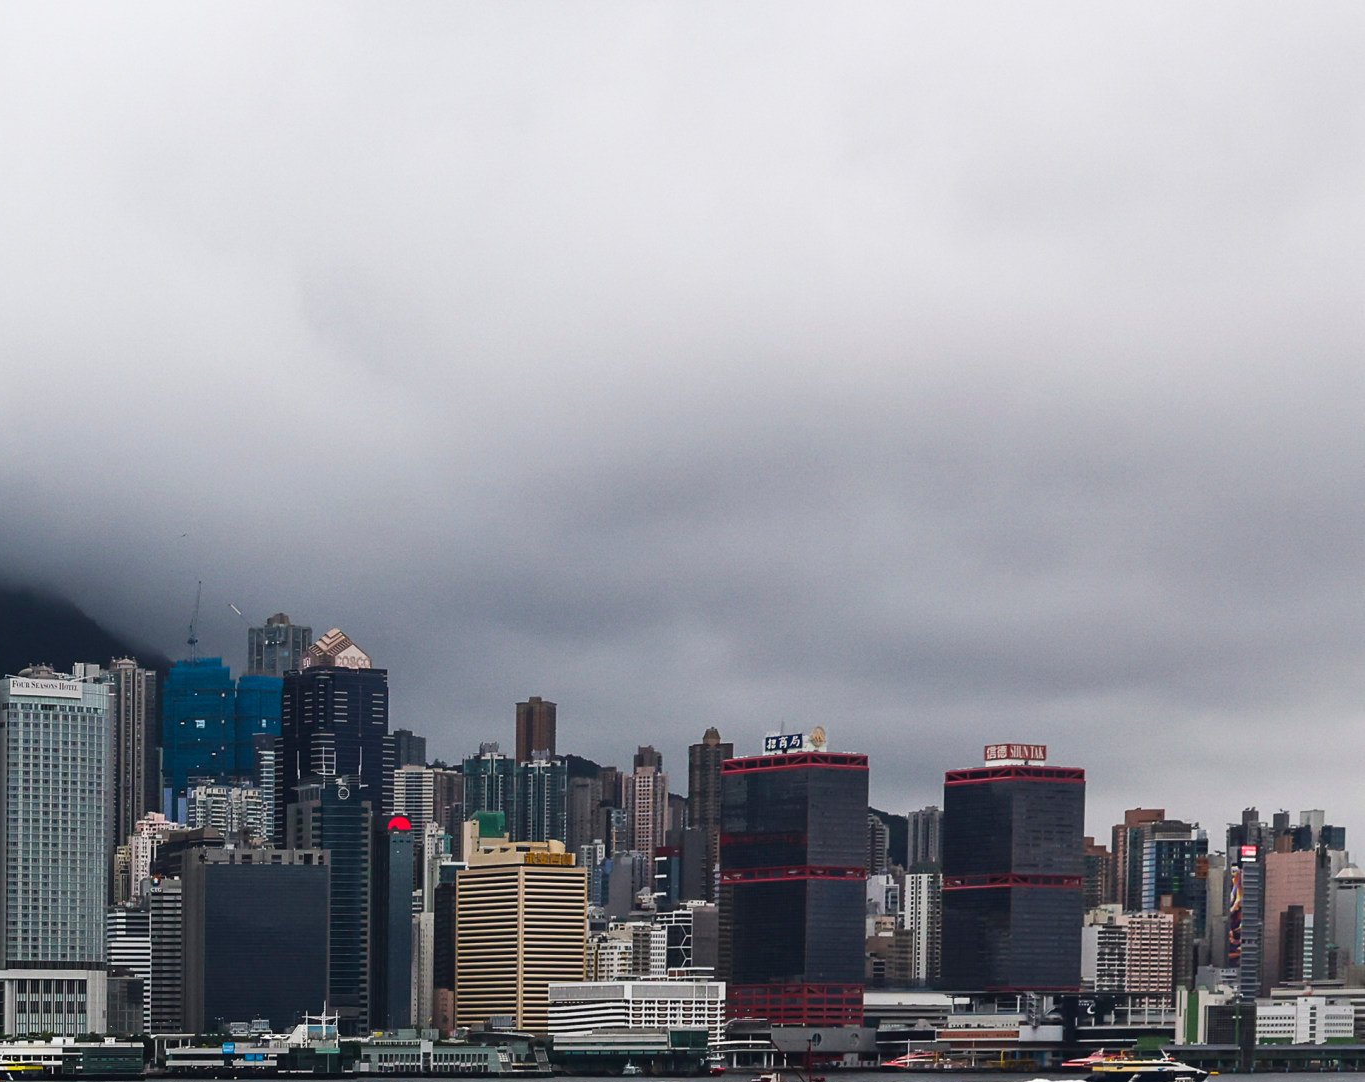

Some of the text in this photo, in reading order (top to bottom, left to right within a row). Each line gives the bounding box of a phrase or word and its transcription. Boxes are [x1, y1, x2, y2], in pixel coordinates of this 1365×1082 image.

[336, 655, 372, 667] COSCO
[12, 680, 78, 691] FOUR SEASONS HOTEL
[767, 736, 800, 749] 招商局
[1010, 745, 1044, 759] SHUN TAK
